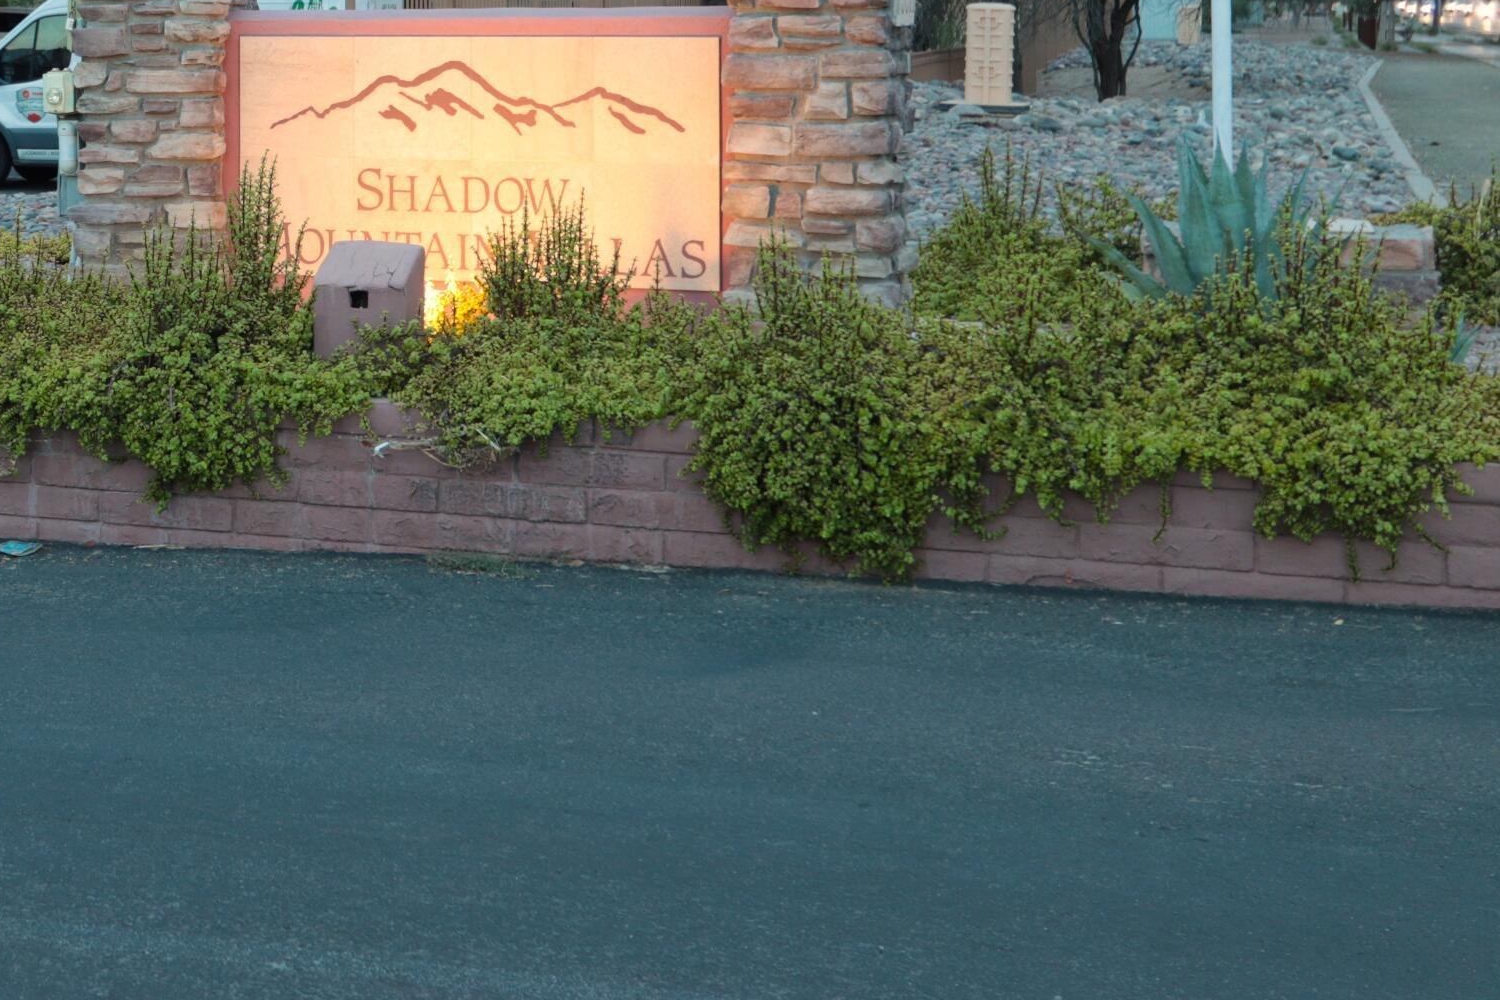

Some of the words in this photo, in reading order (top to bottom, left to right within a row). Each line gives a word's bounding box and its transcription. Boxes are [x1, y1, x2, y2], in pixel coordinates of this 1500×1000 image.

[356, 168, 570, 216] SHADOW
[278, 222, 506, 271] OTAIN
[528, 230, 707, 279] LAS
